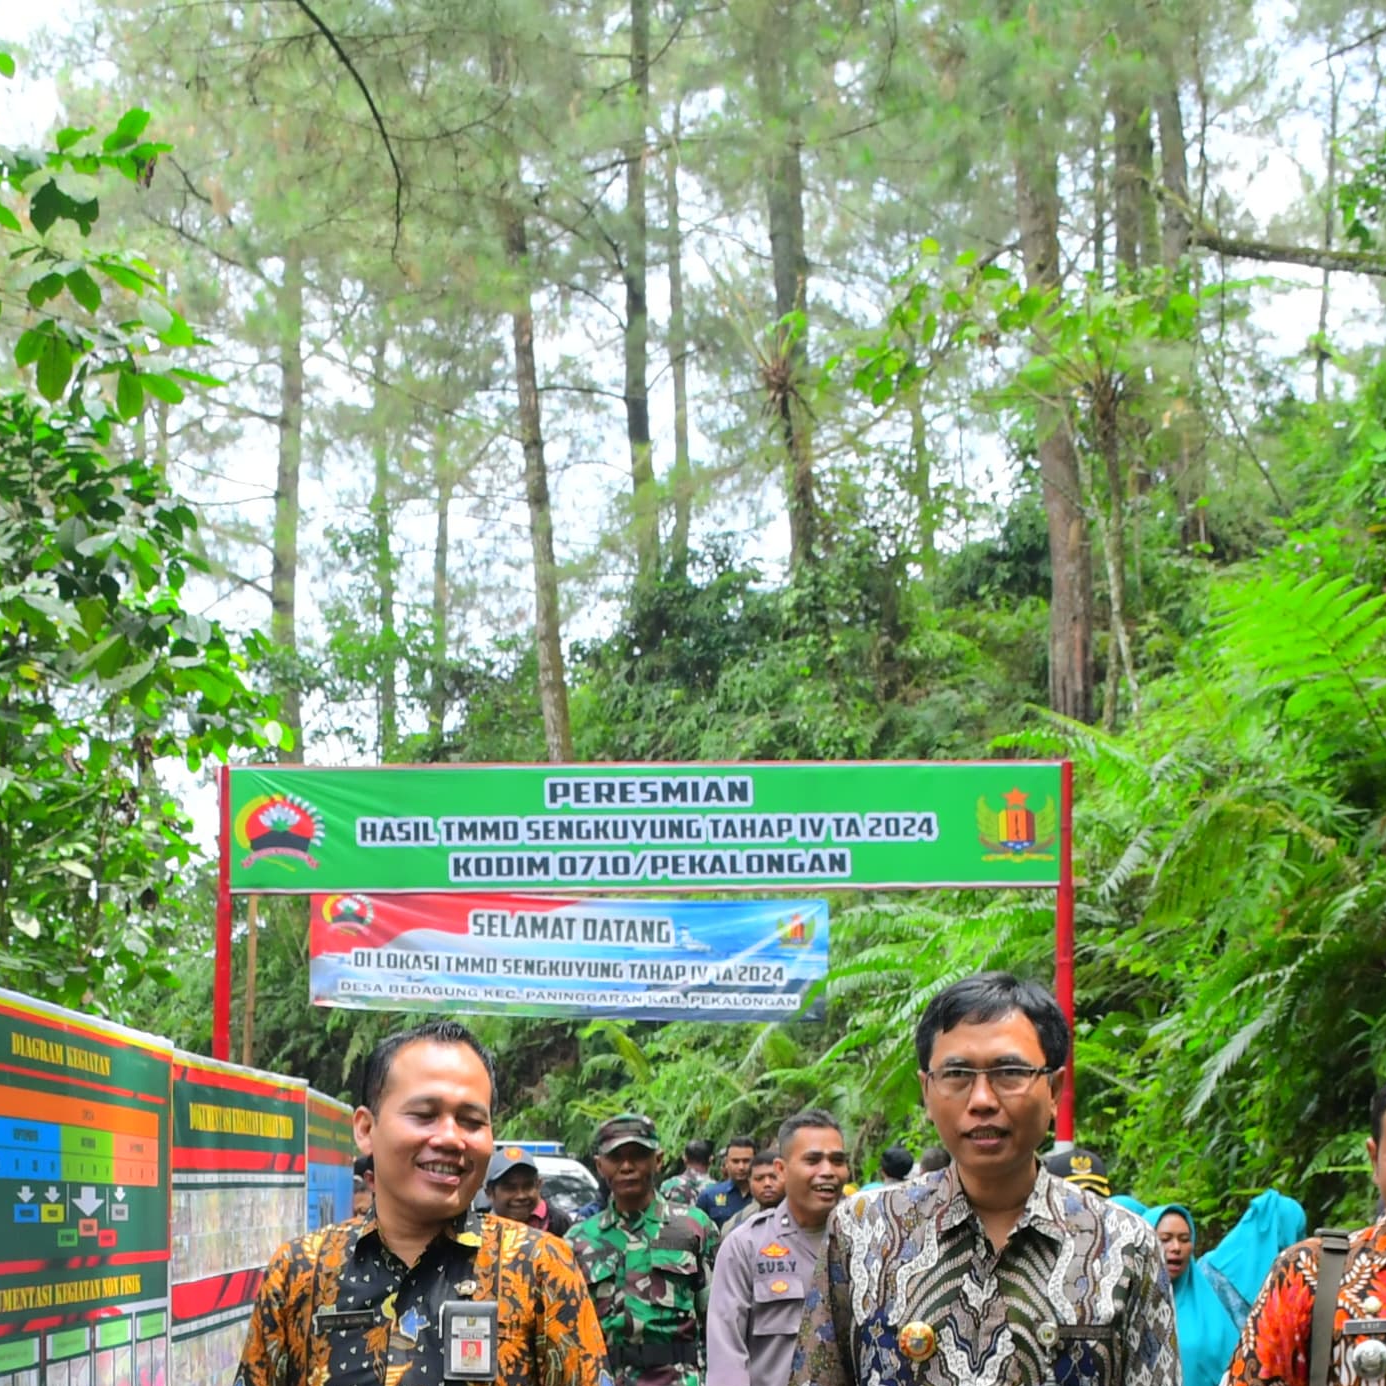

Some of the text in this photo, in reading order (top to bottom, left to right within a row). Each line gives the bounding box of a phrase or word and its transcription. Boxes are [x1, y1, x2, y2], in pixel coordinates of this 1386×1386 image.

[549, 781, 749, 804] PERESMIAN
[359, 816, 934, 842] HASIL TMMD SENGKUYUNG TAHAP IV TA 2024
[453, 853, 847, 877] KODIM 0710/PEKALONGAN
[472, 913, 671, 944] SELAMAT DATANG
[353, 951, 372, 968] DI
[376, 952, 440, 971] LOKASI
[445, 956, 498, 975] TMMD
[503, 959, 623, 979] SENGKUYUNG
[629, 963, 687, 982] TAHAP
[691, 965, 708, 983] IV
[738, 965, 784, 982] 2024
[340, 980, 382, 993] DESA
[389, 982, 478, 998] BEDAGUNG
[484, 987, 520, 1000] KEC.
[525, 989, 642, 1004] PANINGGARAN
[690, 995, 798, 1008] PEKALONGAN
[11, 1031, 110, 1076] DIAGRAM KEGIATAN
[55, 1278, 101, 1304] KEGIATAN
[102, 1276, 119, 1298] NON
[120, 1274, 141, 1296] FISIK
